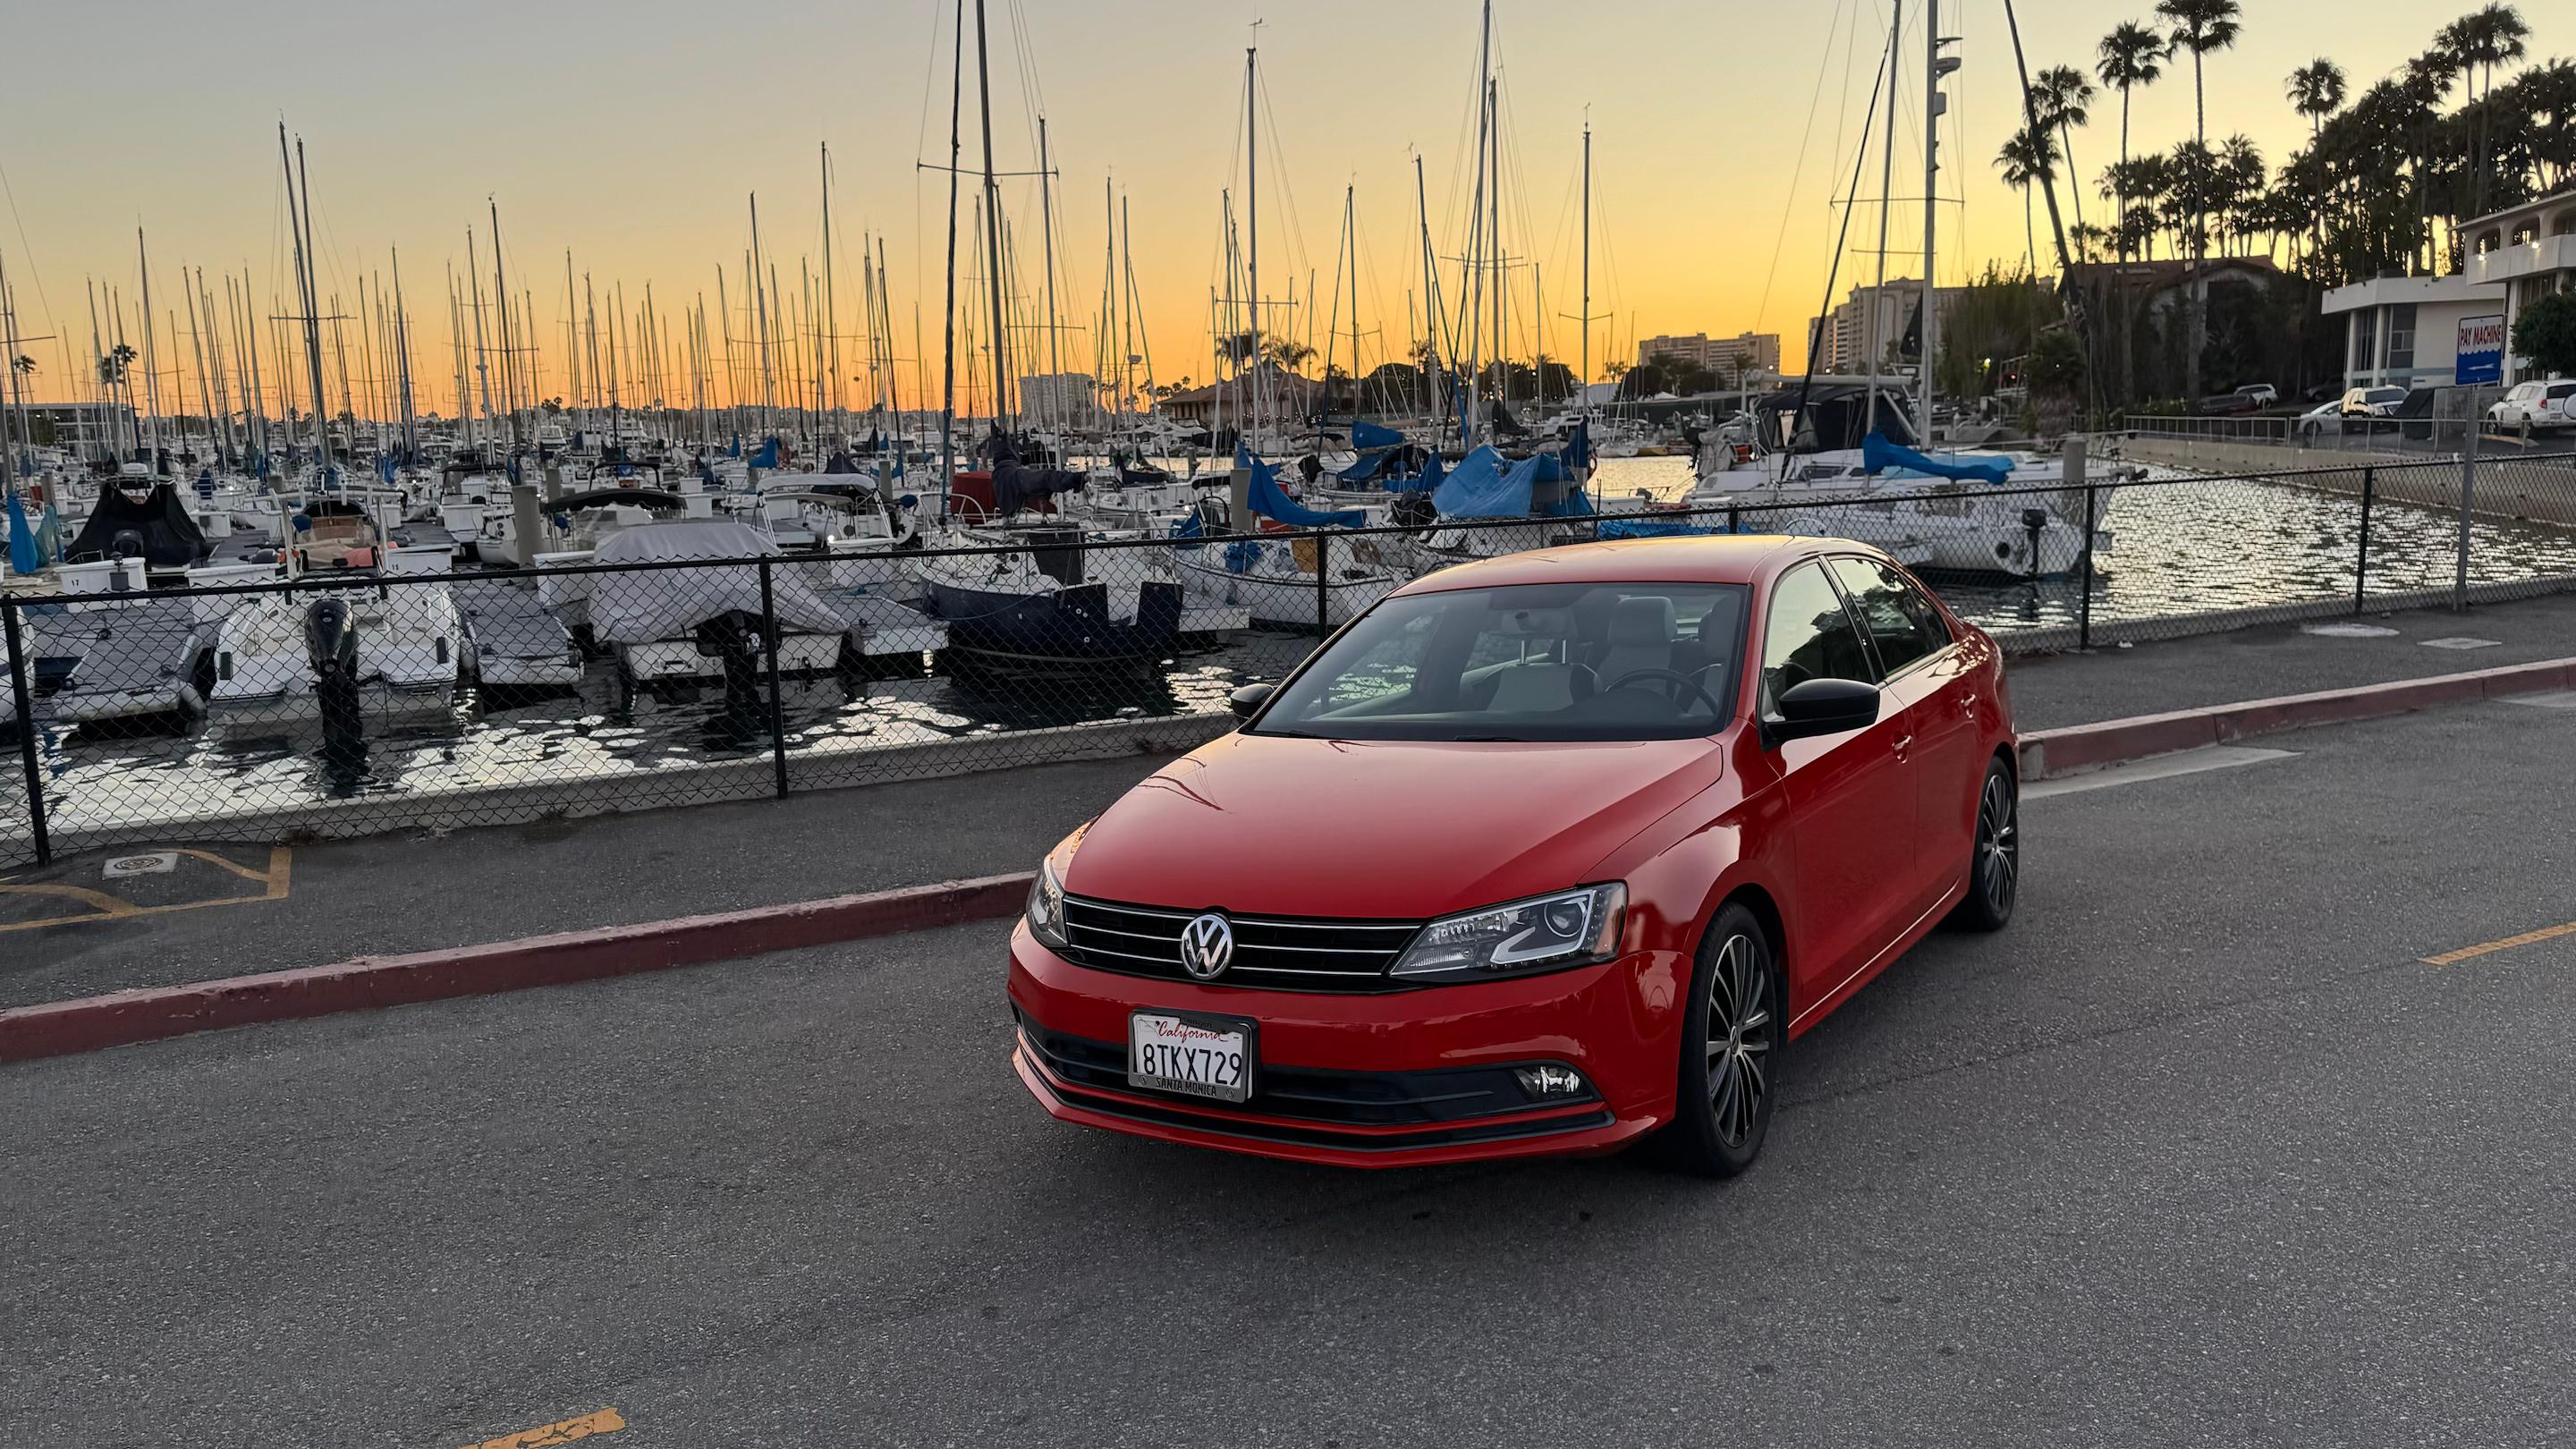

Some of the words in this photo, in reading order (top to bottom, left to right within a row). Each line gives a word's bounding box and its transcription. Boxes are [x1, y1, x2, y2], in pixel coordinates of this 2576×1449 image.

[2461, 327, 2472, 346] PAY
[2474, 324, 2501, 345] MACHINE
[1158, 1021, 1228, 1044] California
[1142, 1043, 1242, 1086] 8TKX729
[1156, 1077, 1182, 1092] SANTA
[1185, 1080, 1217, 1097] MONICA
